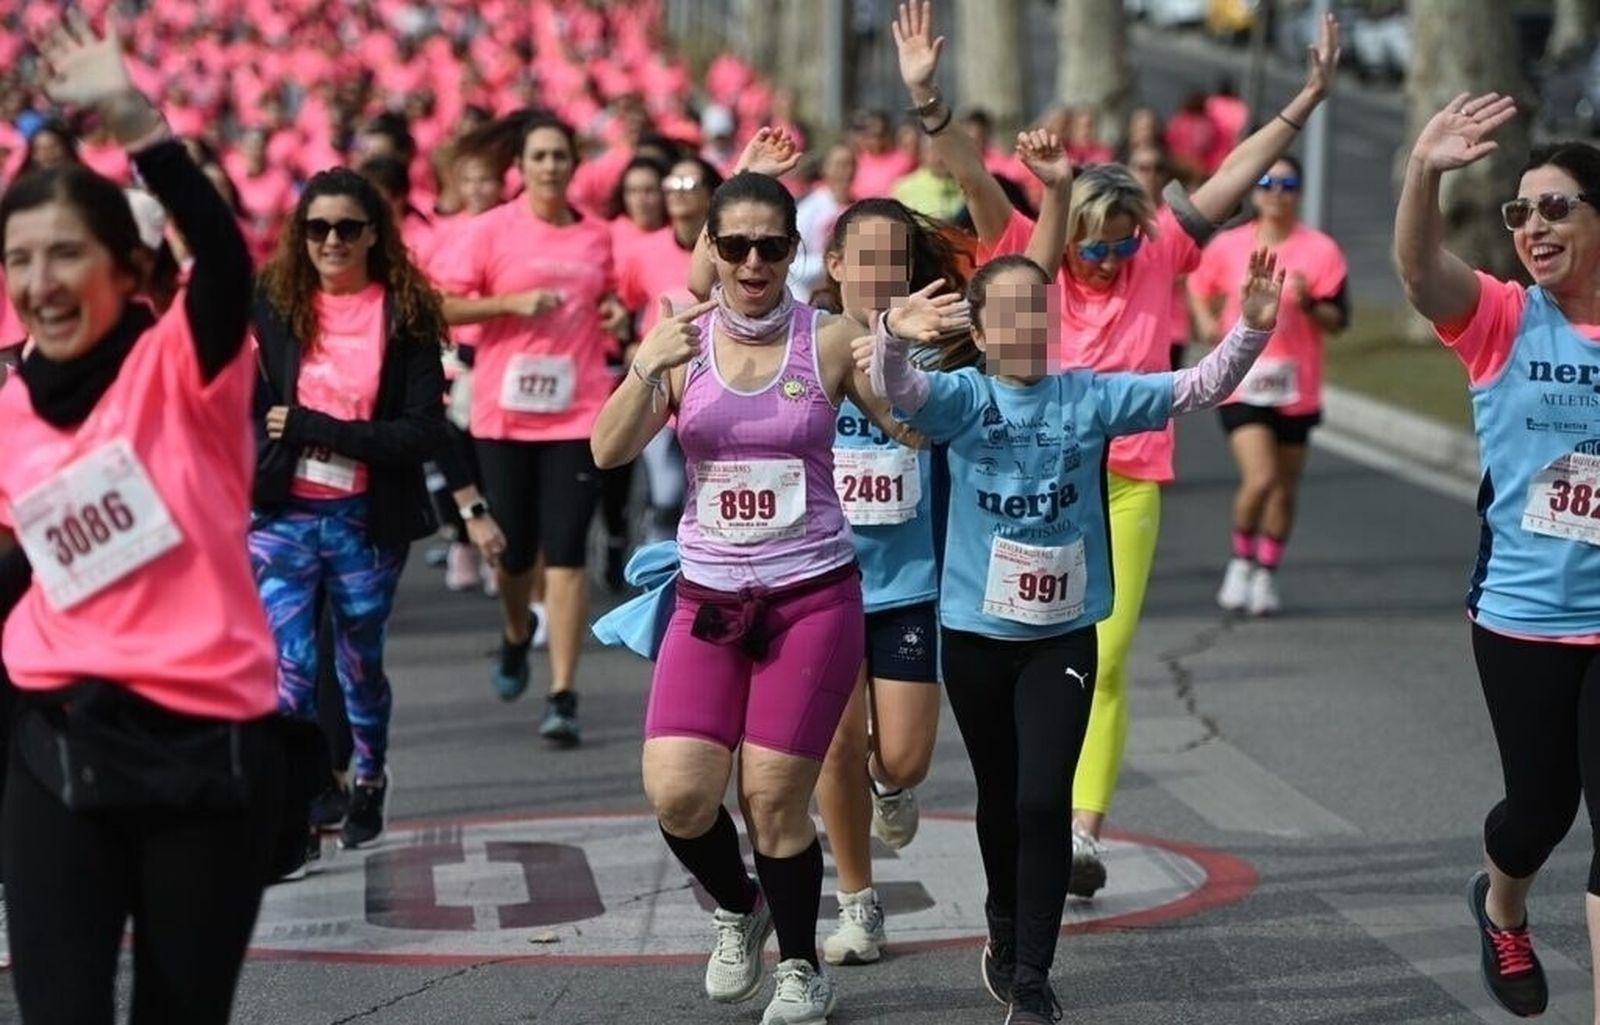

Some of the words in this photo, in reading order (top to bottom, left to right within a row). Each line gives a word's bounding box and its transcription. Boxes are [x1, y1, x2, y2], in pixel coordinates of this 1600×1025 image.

[1529, 359, 1600, 394] ner
[720, 489, 776, 520] 899
[842, 474, 904, 503] 2481
[976, 482, 1079, 522] nerja
[1549, 480, 1600, 519] 382
[45, 489, 135, 566] 3086
[1018, 572, 1068, 603] 991
